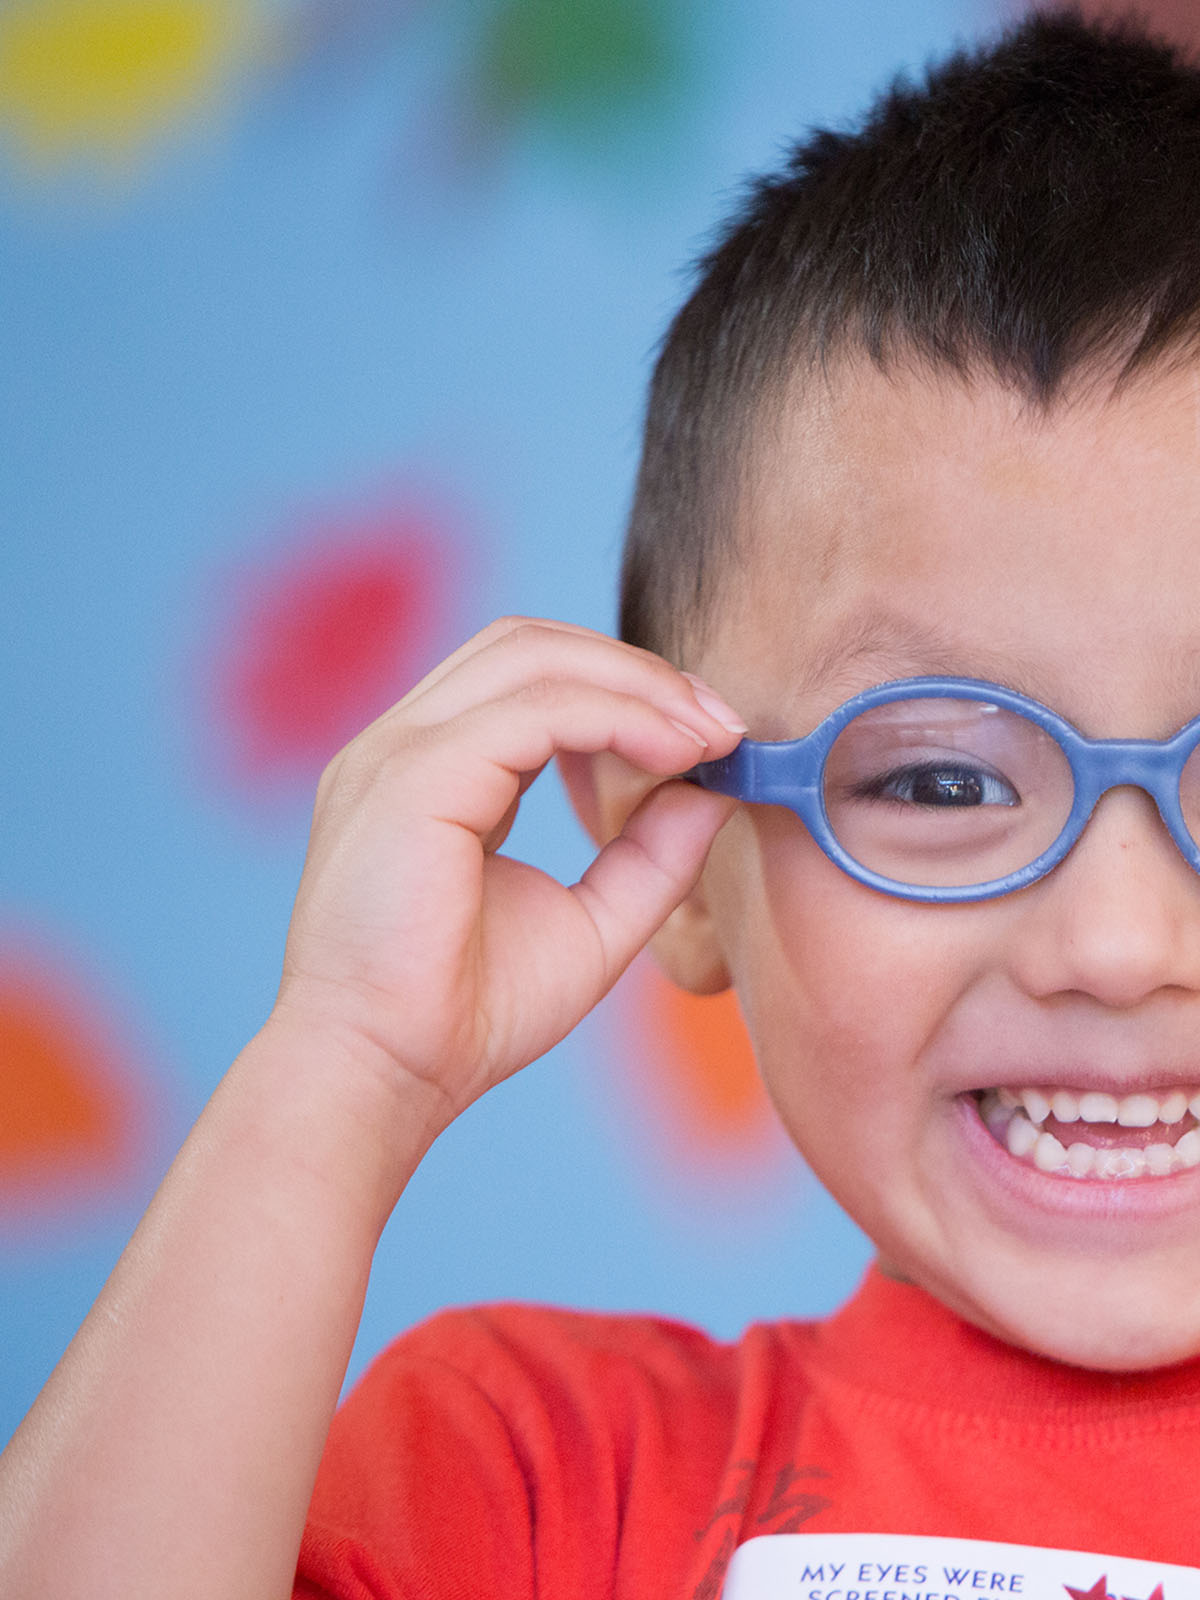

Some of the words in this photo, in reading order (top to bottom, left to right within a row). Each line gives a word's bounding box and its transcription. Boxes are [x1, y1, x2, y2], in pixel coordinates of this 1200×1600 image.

[800, 1563, 846, 1584] MY
[858, 1563, 929, 1585] EYES
[943, 1566, 1025, 1594] WERE
